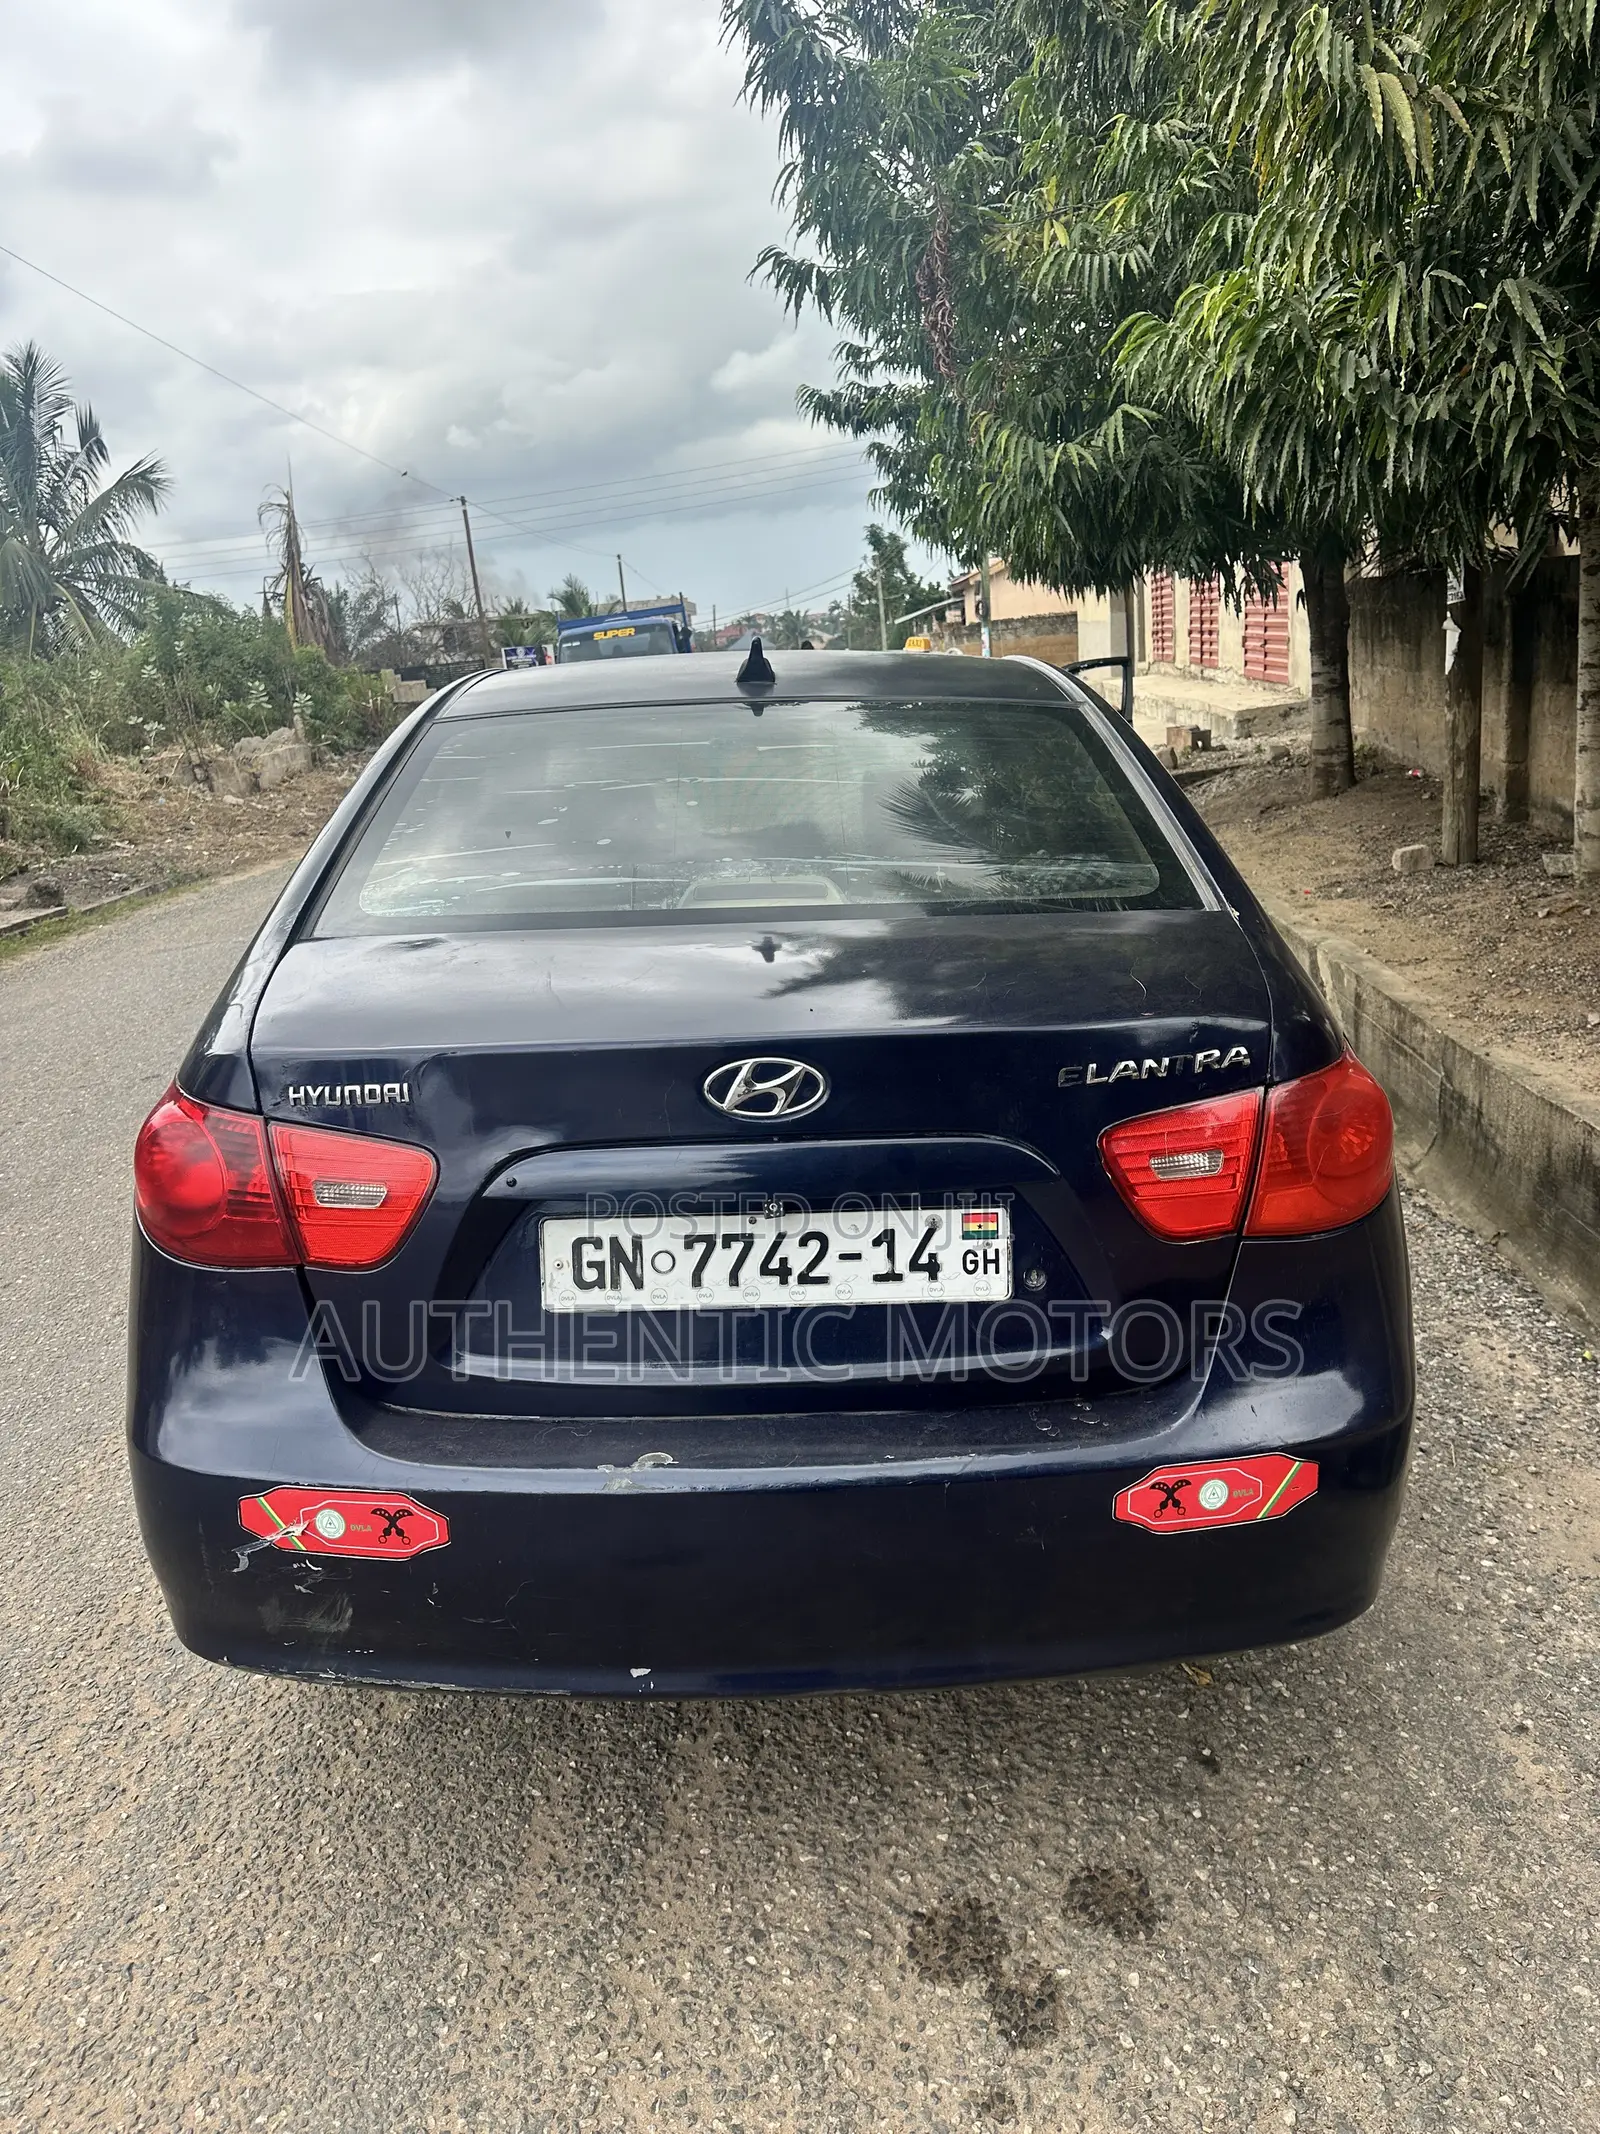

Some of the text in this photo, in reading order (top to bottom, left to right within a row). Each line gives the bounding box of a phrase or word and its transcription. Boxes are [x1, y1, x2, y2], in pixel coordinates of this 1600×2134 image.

[593, 628, 635, 640] SUPER
[1058, 1046, 1251, 1088] ELANTRA
[288, 1082, 410, 1106] HYUNDAI
[571, 1228, 941, 1291] GN 7742-14
[962, 1248, 1000, 1275] GH
